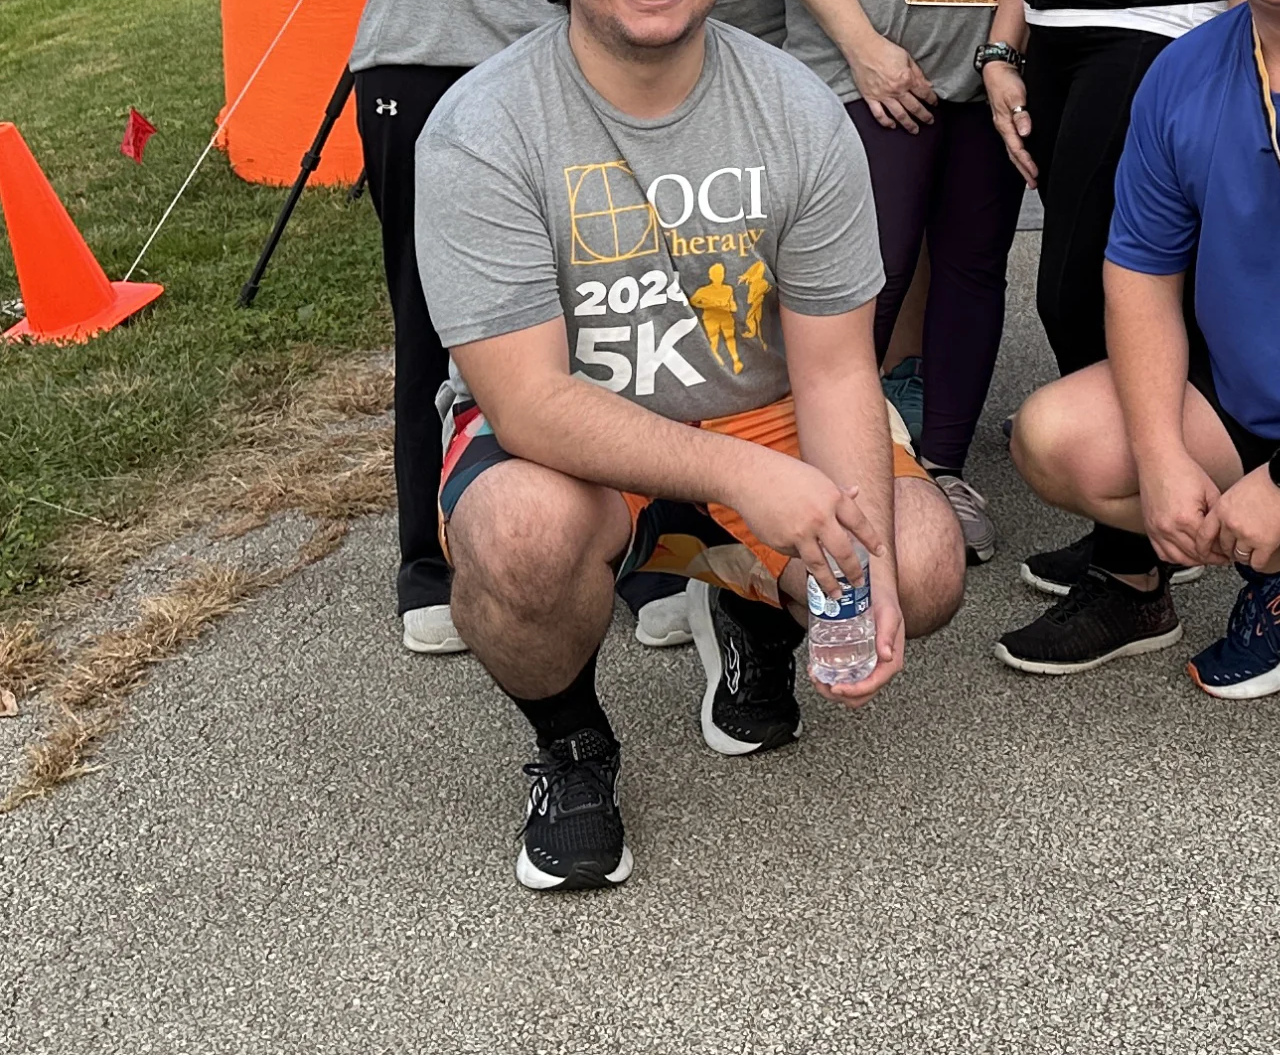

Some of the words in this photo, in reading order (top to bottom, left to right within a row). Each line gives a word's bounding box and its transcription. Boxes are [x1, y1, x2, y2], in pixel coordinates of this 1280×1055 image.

[646, 166, 768, 229] OCI
[663, 229, 765, 257] herapy
[574, 270, 690, 316] 2024
[570, 316, 707, 396] 5K
